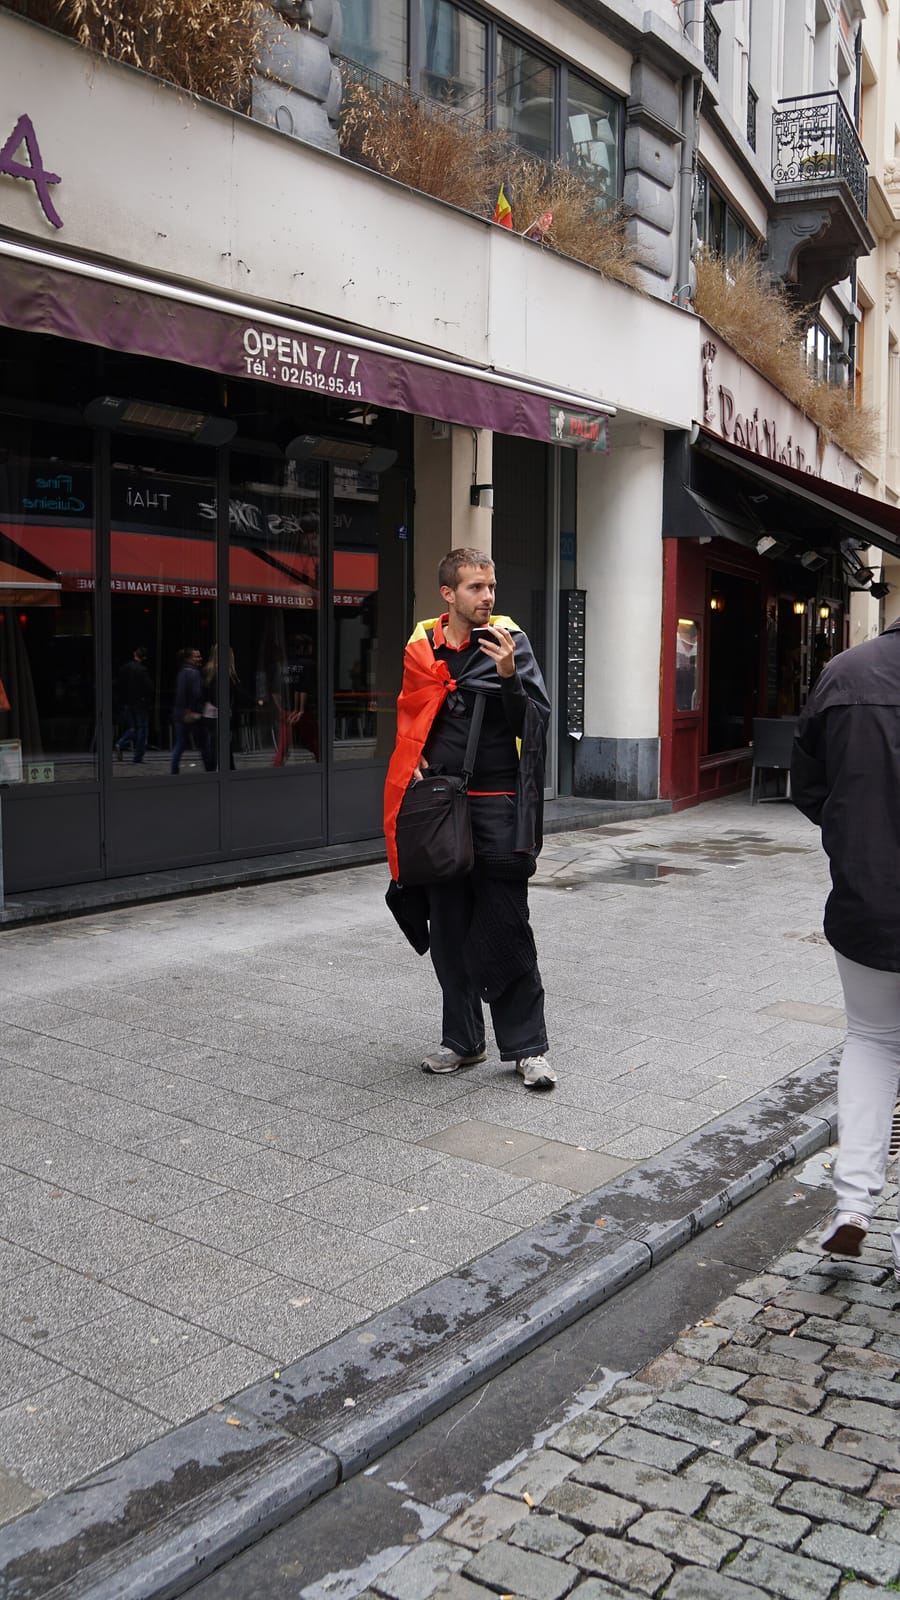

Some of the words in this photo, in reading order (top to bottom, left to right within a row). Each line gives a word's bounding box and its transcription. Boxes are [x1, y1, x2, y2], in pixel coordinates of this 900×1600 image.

[243, 328, 308, 367] OPEN
[314, 345, 327, 370] 7
[347, 353, 360, 377] 7
[281, 366, 362, 396] 02/512.95.41
[569, 417, 600, 441] PALM
